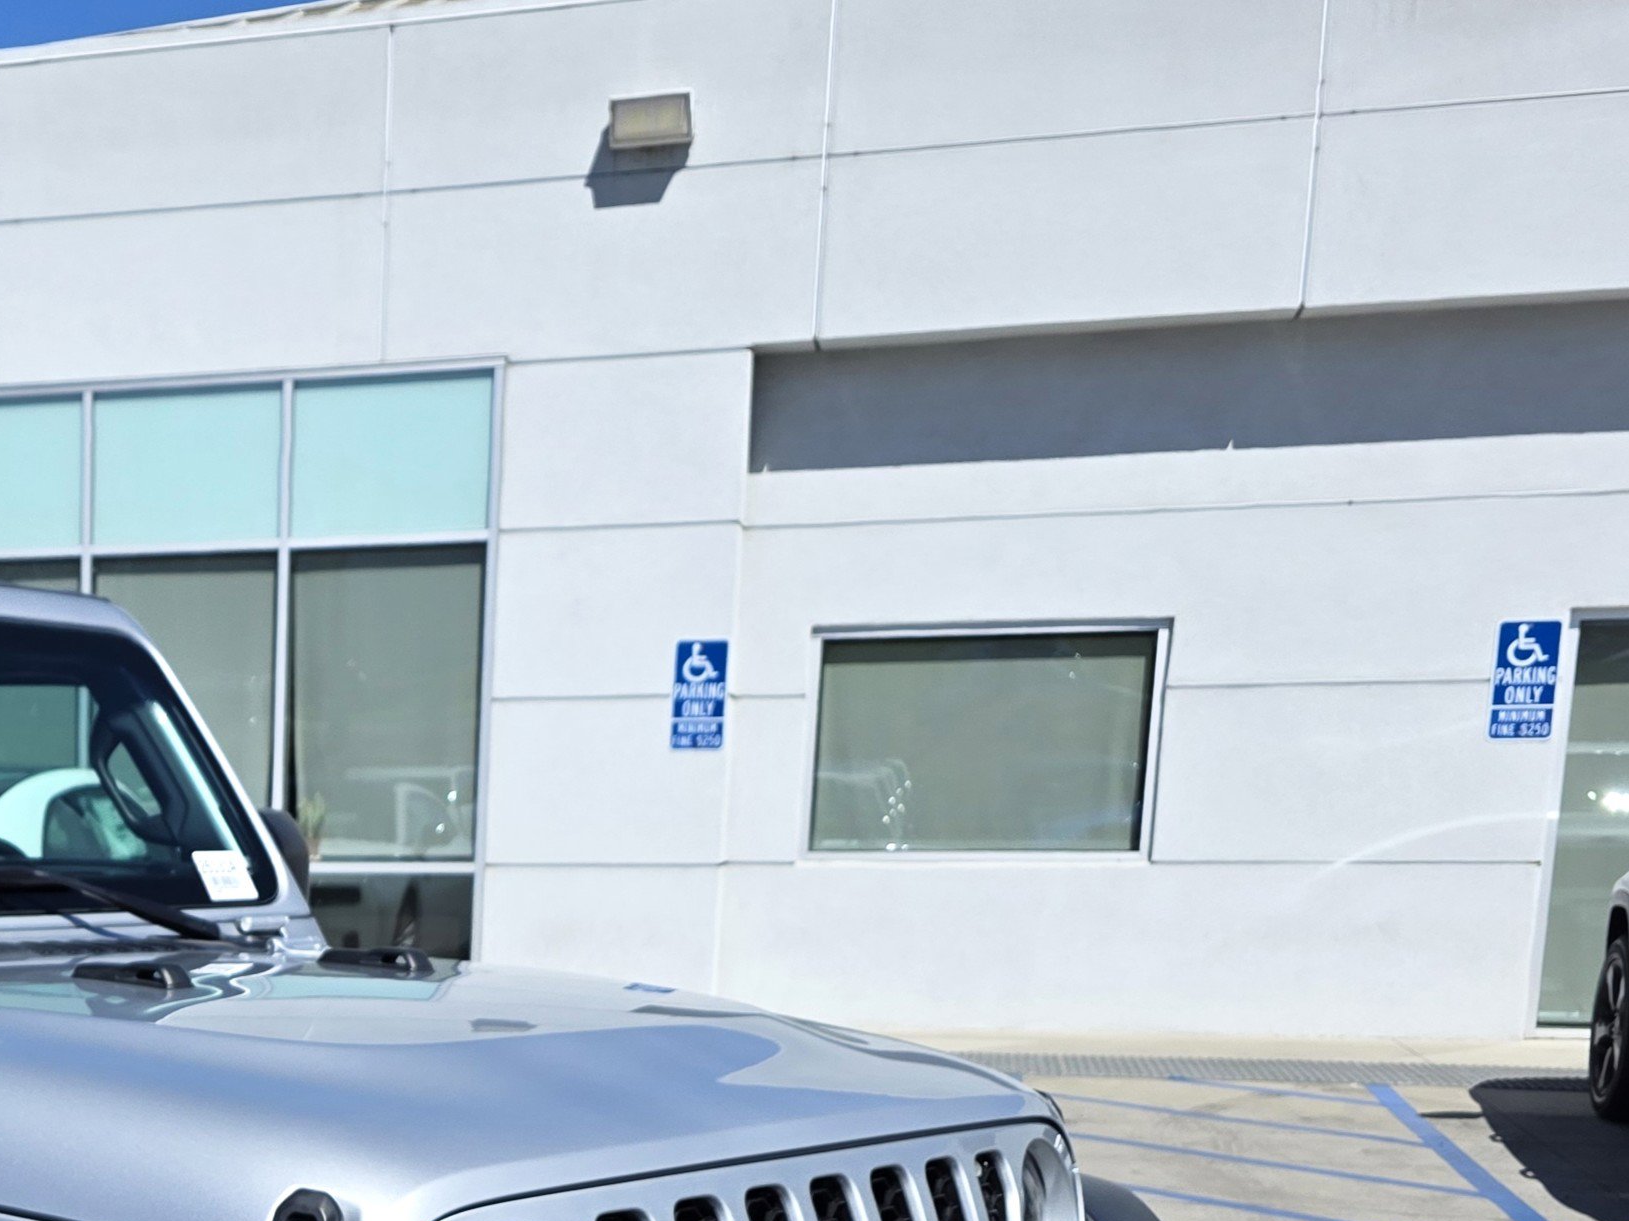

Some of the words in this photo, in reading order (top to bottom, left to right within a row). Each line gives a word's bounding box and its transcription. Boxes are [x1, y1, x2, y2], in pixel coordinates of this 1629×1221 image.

[1494, 666, 1556, 686] PARKING
[673, 682, 725, 700] PARKING
[1504, 686, 1543, 704] ONLY
[681, 700, 715, 716] ONLY
[1497, 710, 1546, 723] MINIMUM
[677, 721, 718, 733] MINIMUM
[1491, 723, 1516, 736] FINE
[1519, 722, 1550, 736] $250
[672, 734, 693, 747] FINE
